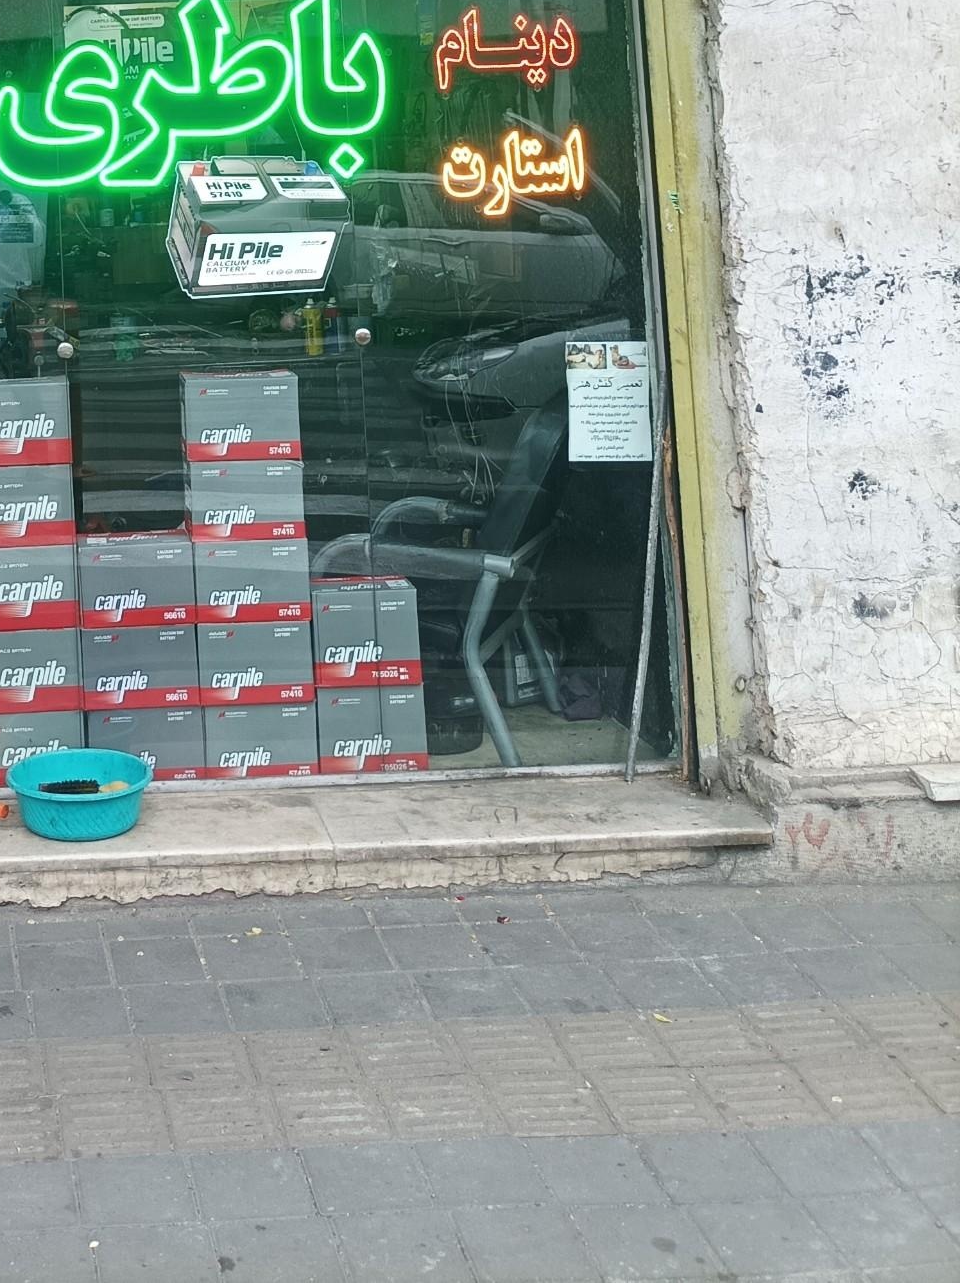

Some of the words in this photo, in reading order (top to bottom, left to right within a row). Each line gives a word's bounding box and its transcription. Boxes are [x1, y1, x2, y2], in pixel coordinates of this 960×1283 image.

[436, 8, 576, 90] دینام
[206, 181, 223, 190] Hi
[224, 181, 252, 190] Pile
[442, 127, 585, 216] استارت
[206, 259, 251, 267] CALCIUM
[251, 258, 272, 266] SMF
[208, 242, 234, 261] Hi
[239, 241, 284, 259] Pile
[205, 266, 248, 274] BATTERY
[617, 379, 643, 391] تعمیر
[201, 424, 252, 456] carpile
[204, 505, 256, 537] carpile
[95, 589, 146, 623] carpile
[210, 585, 262, 618] carpile
[278, 608, 301, 616] 57410
[324, 640, 383, 677] carpile
[0, 660, 66, 703] carpile
[96, 670, 148, 704] carpile
[211, 667, 263, 700] carpile
[280, 690, 304, 698] 57410
[220, 746, 271, 777] carpile
[334, 734, 392, 770] carpile
